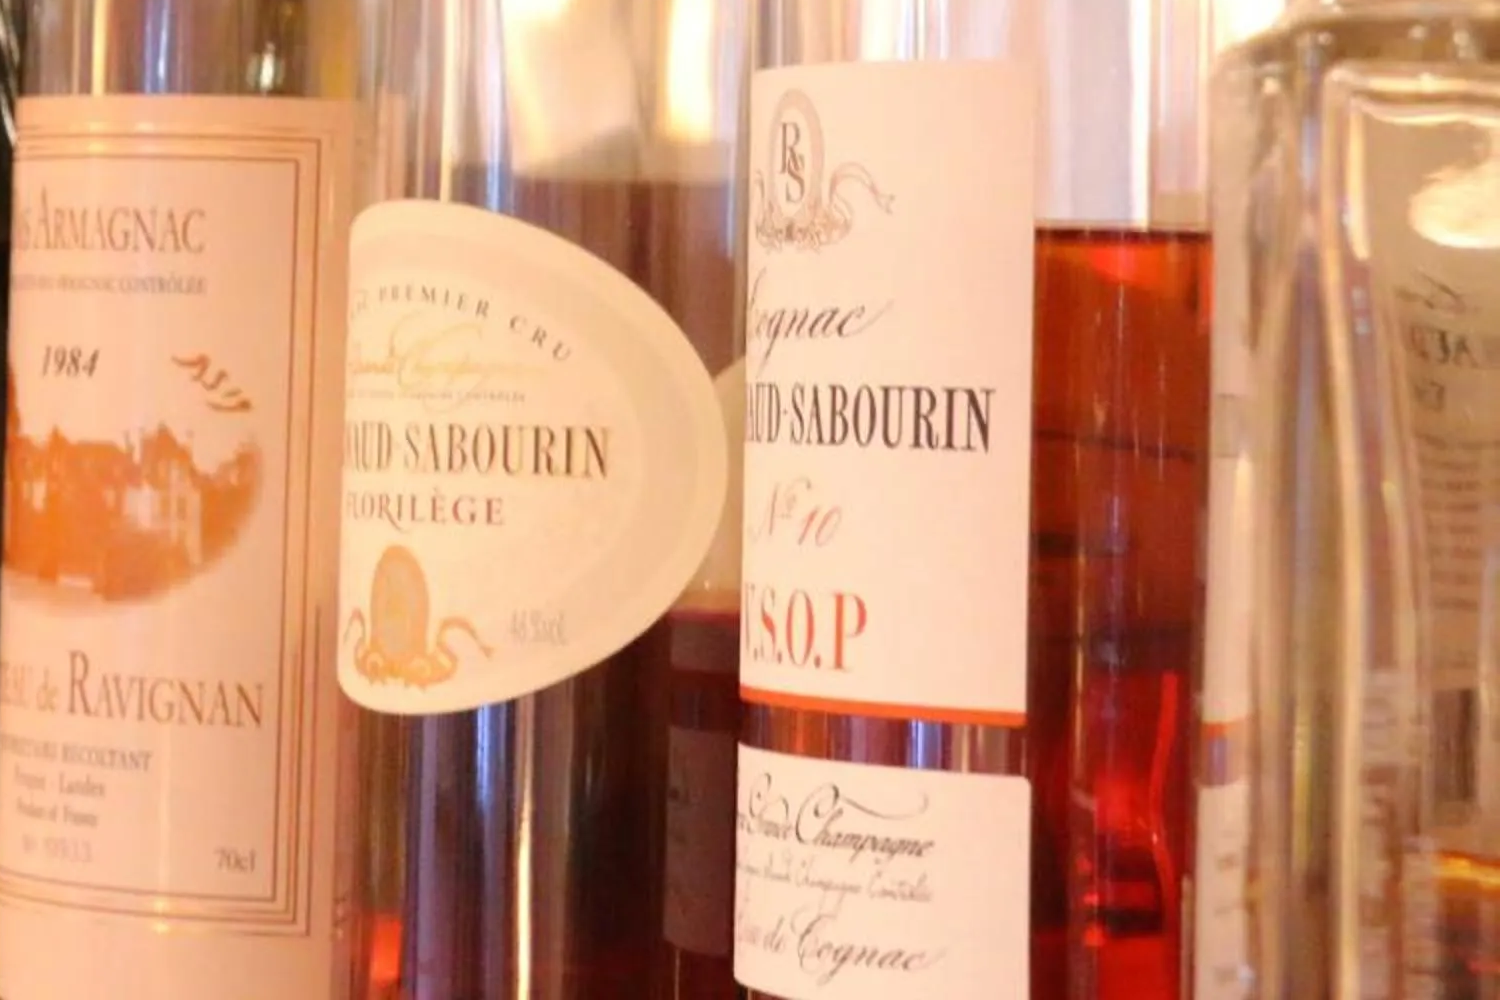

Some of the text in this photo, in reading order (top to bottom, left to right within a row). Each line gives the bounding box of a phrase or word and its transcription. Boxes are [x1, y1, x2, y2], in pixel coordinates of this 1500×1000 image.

[33, 186, 206, 254] ARMAGNAC
[378, 280, 491, 318] PREMIER
[509, 314, 573, 363] CRU
[40, 345, 100, 379] 1984
[67, 649, 265, 729] RAVIGNAN
[213, 848, 258, 873] 70cl
[789, 903, 949, 987] Cognac
